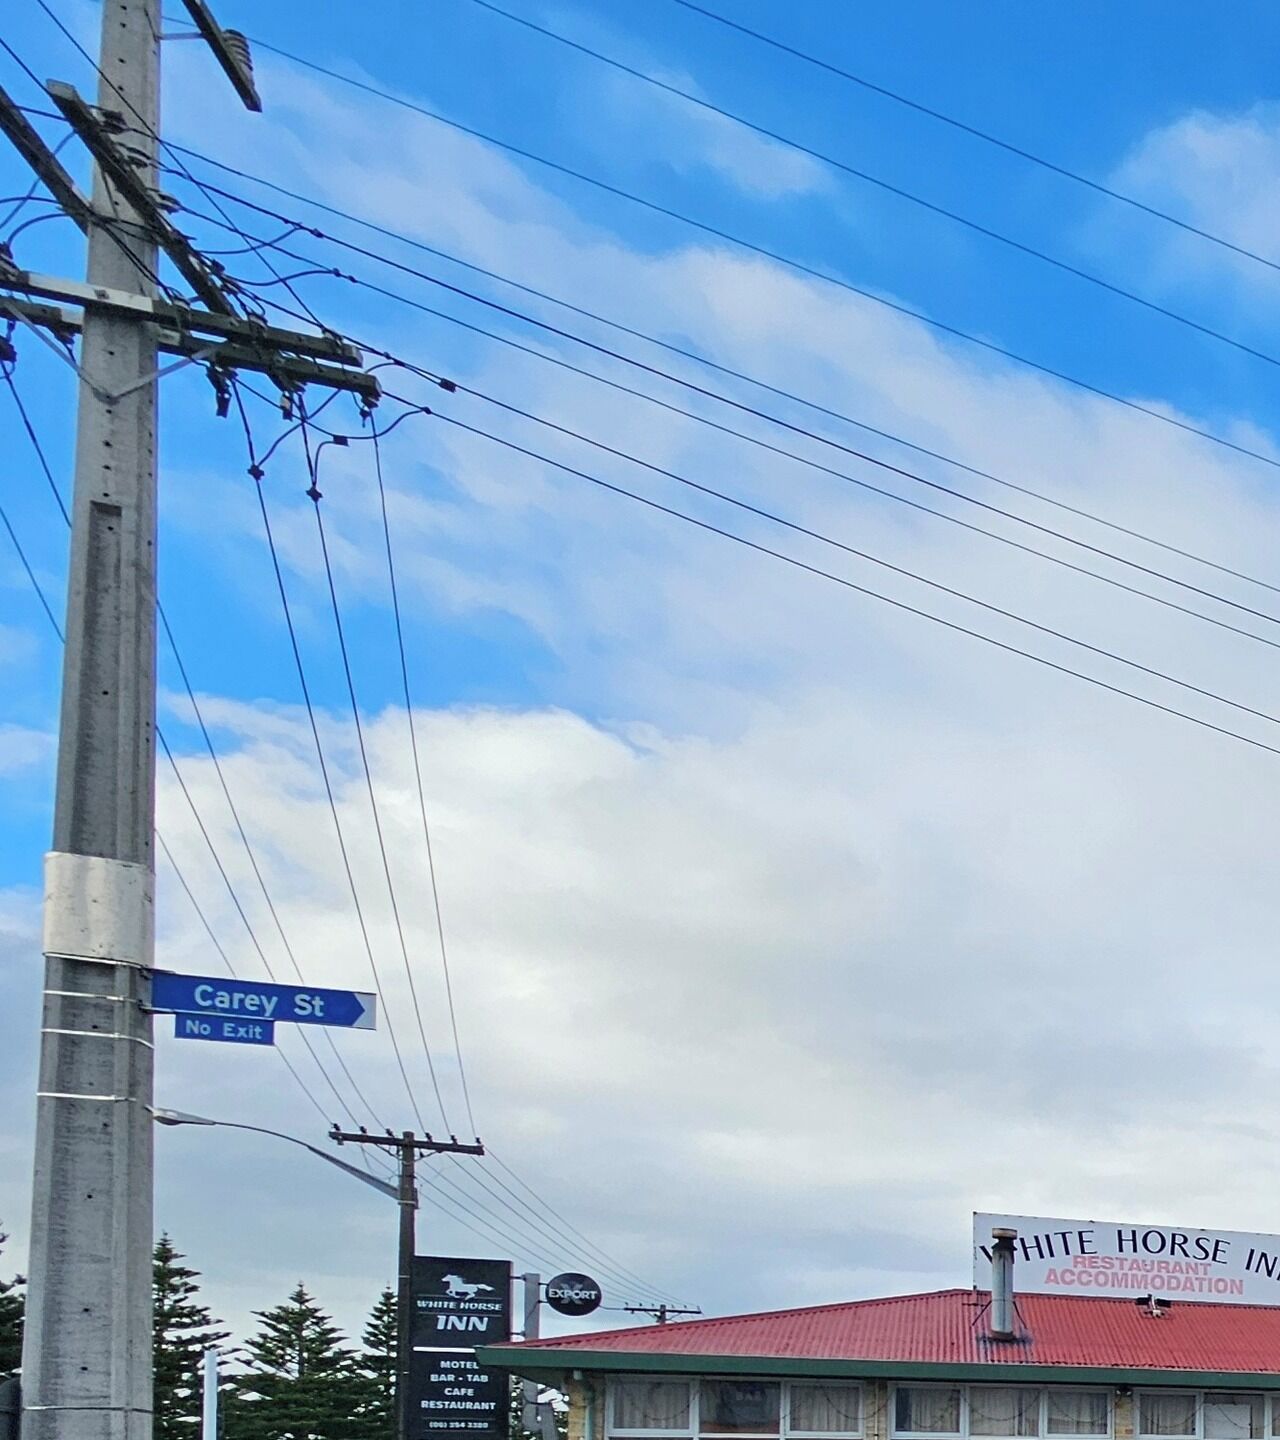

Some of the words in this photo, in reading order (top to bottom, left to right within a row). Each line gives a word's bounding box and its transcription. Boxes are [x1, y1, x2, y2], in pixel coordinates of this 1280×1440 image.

[193, 984, 279, 1017] Carey
[293, 993, 325, 1017] St
[185, 1019, 211, 1035] No
[223, 1022, 263, 1040] Exit
[1116, 1229, 1231, 1264] HORSE
[1072, 1254, 1212, 1277] RESTAURANT
[1044, 1269, 1244, 1295] ACCOMMODATION
[548, 1288, 598, 1300] EXPORT
[416, 1299, 456, 1310] WHITE
[460, 1301, 503, 1311] HORSE
[436, 1315, 489, 1332] INN
[440, 1360, 479, 1369] MOTEL
[430, 1374, 455, 1382] BAR
[466, 1374, 489, 1382] TAB
[444, 1388, 475, 1396] CAFE
[421, 1400, 496, 1410] RESTAURANT
